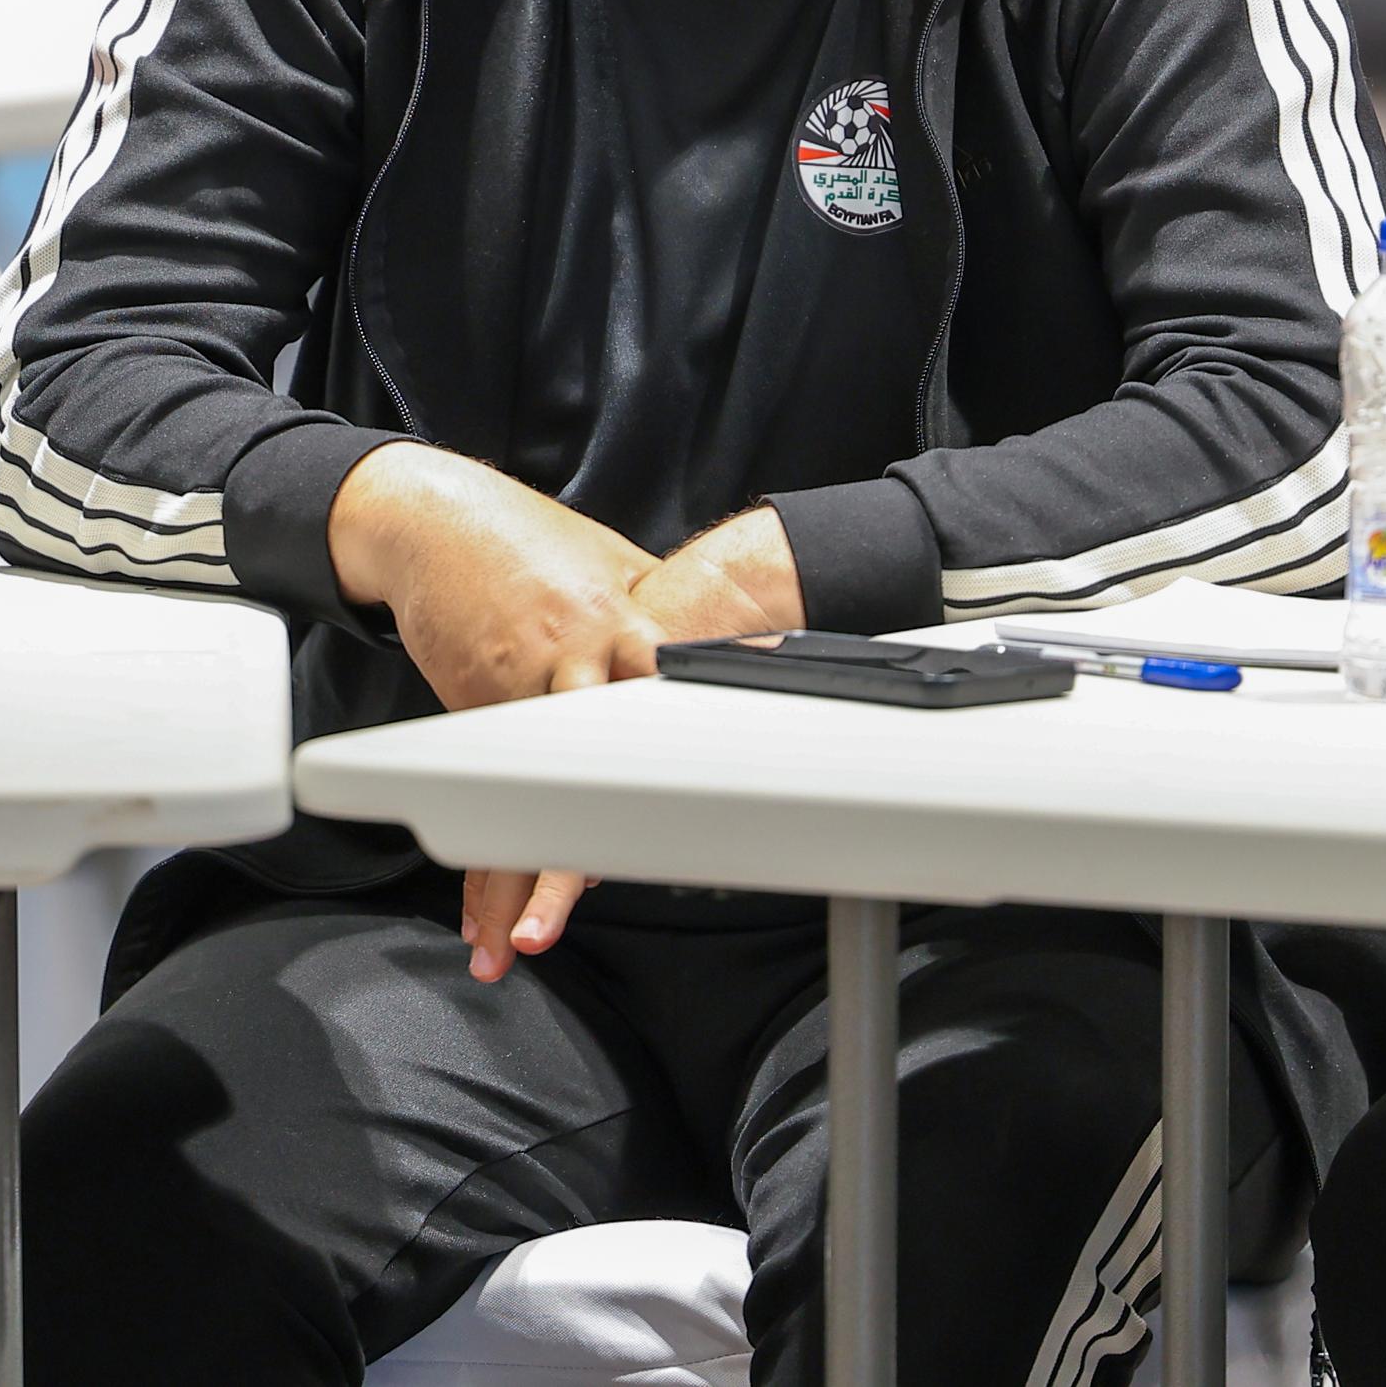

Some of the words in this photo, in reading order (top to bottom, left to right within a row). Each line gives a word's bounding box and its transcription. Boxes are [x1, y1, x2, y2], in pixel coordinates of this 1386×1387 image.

[813, 169, 868, 189] المصري
[824, 185, 863, 207] القدم
[827, 202, 879, 226] EGYPTIAN
[878, 209, 897, 224] FA
